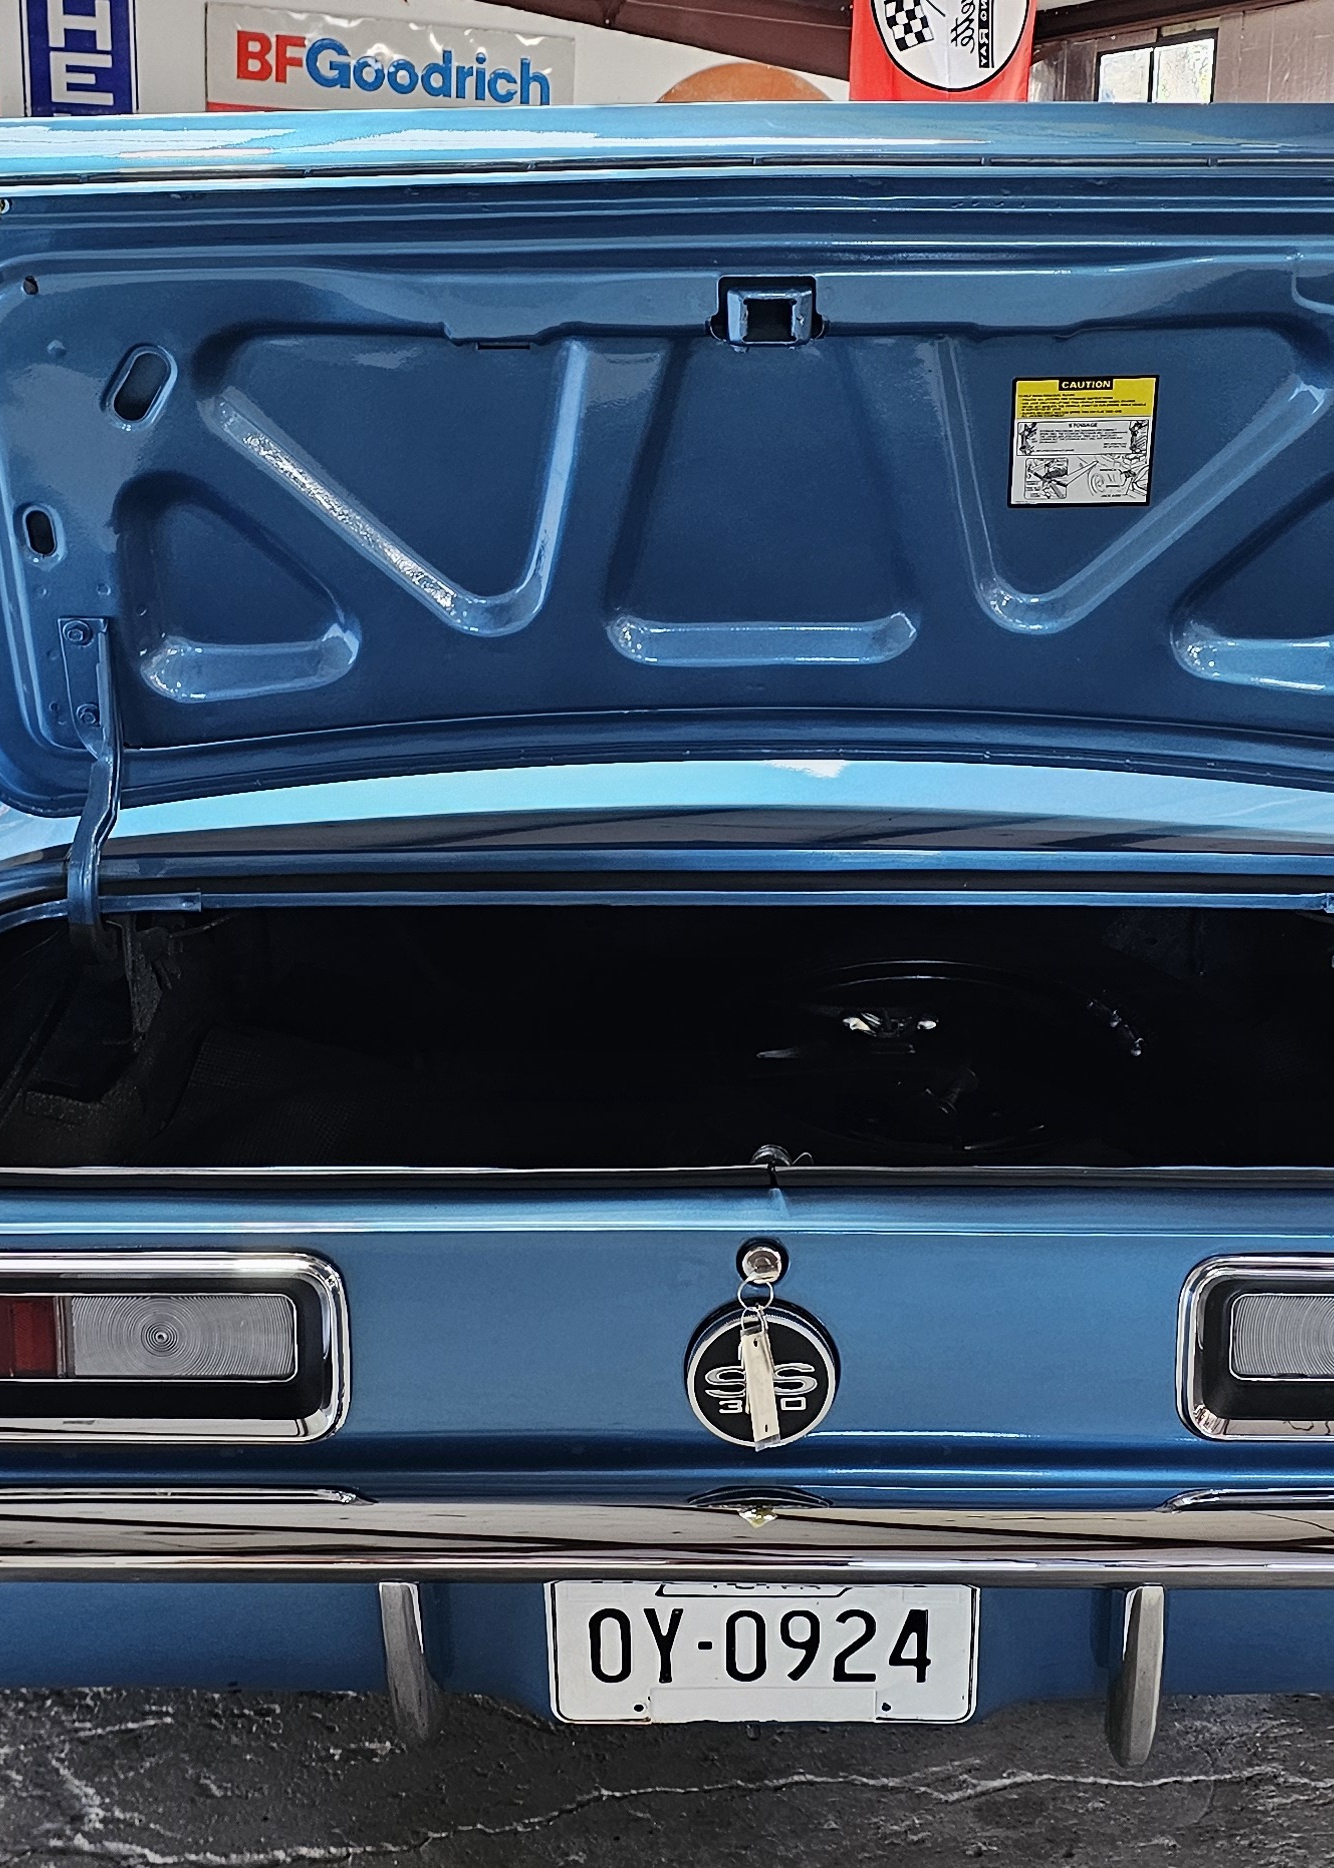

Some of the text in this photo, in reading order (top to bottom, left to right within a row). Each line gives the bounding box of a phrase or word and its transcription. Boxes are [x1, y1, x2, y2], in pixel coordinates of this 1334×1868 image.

[236, 29, 551, 106] BFGoodrich
[1061, 380, 1111, 389] CAUTION
[704, 1362, 819, 1400] SS
[718, 1396, 807, 1414] 30
